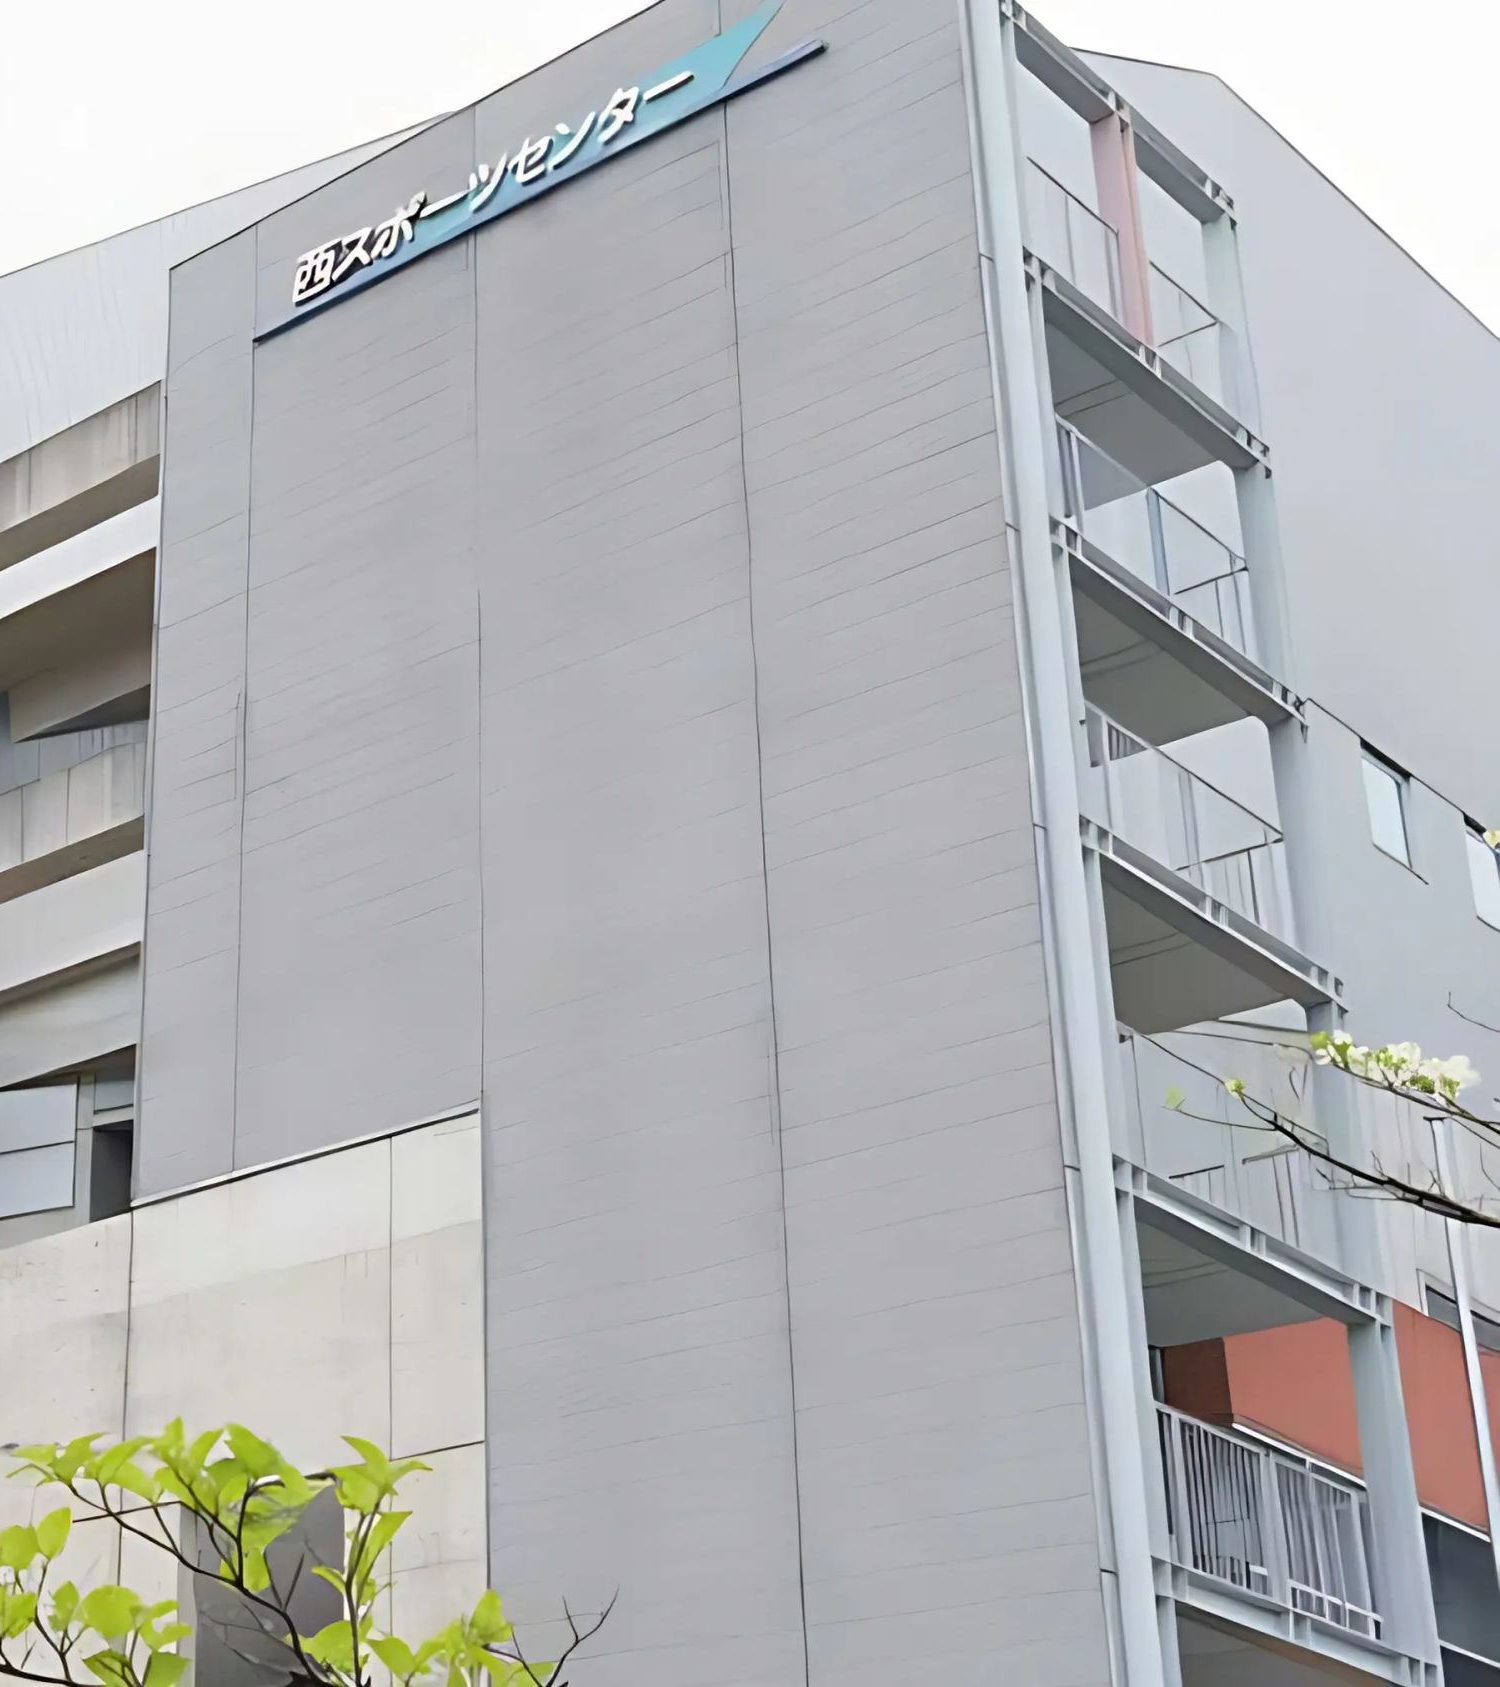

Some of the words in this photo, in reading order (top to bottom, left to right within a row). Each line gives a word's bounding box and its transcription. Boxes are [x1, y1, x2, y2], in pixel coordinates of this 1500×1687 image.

[291, 69, 695, 304] 西スポーツセンター
